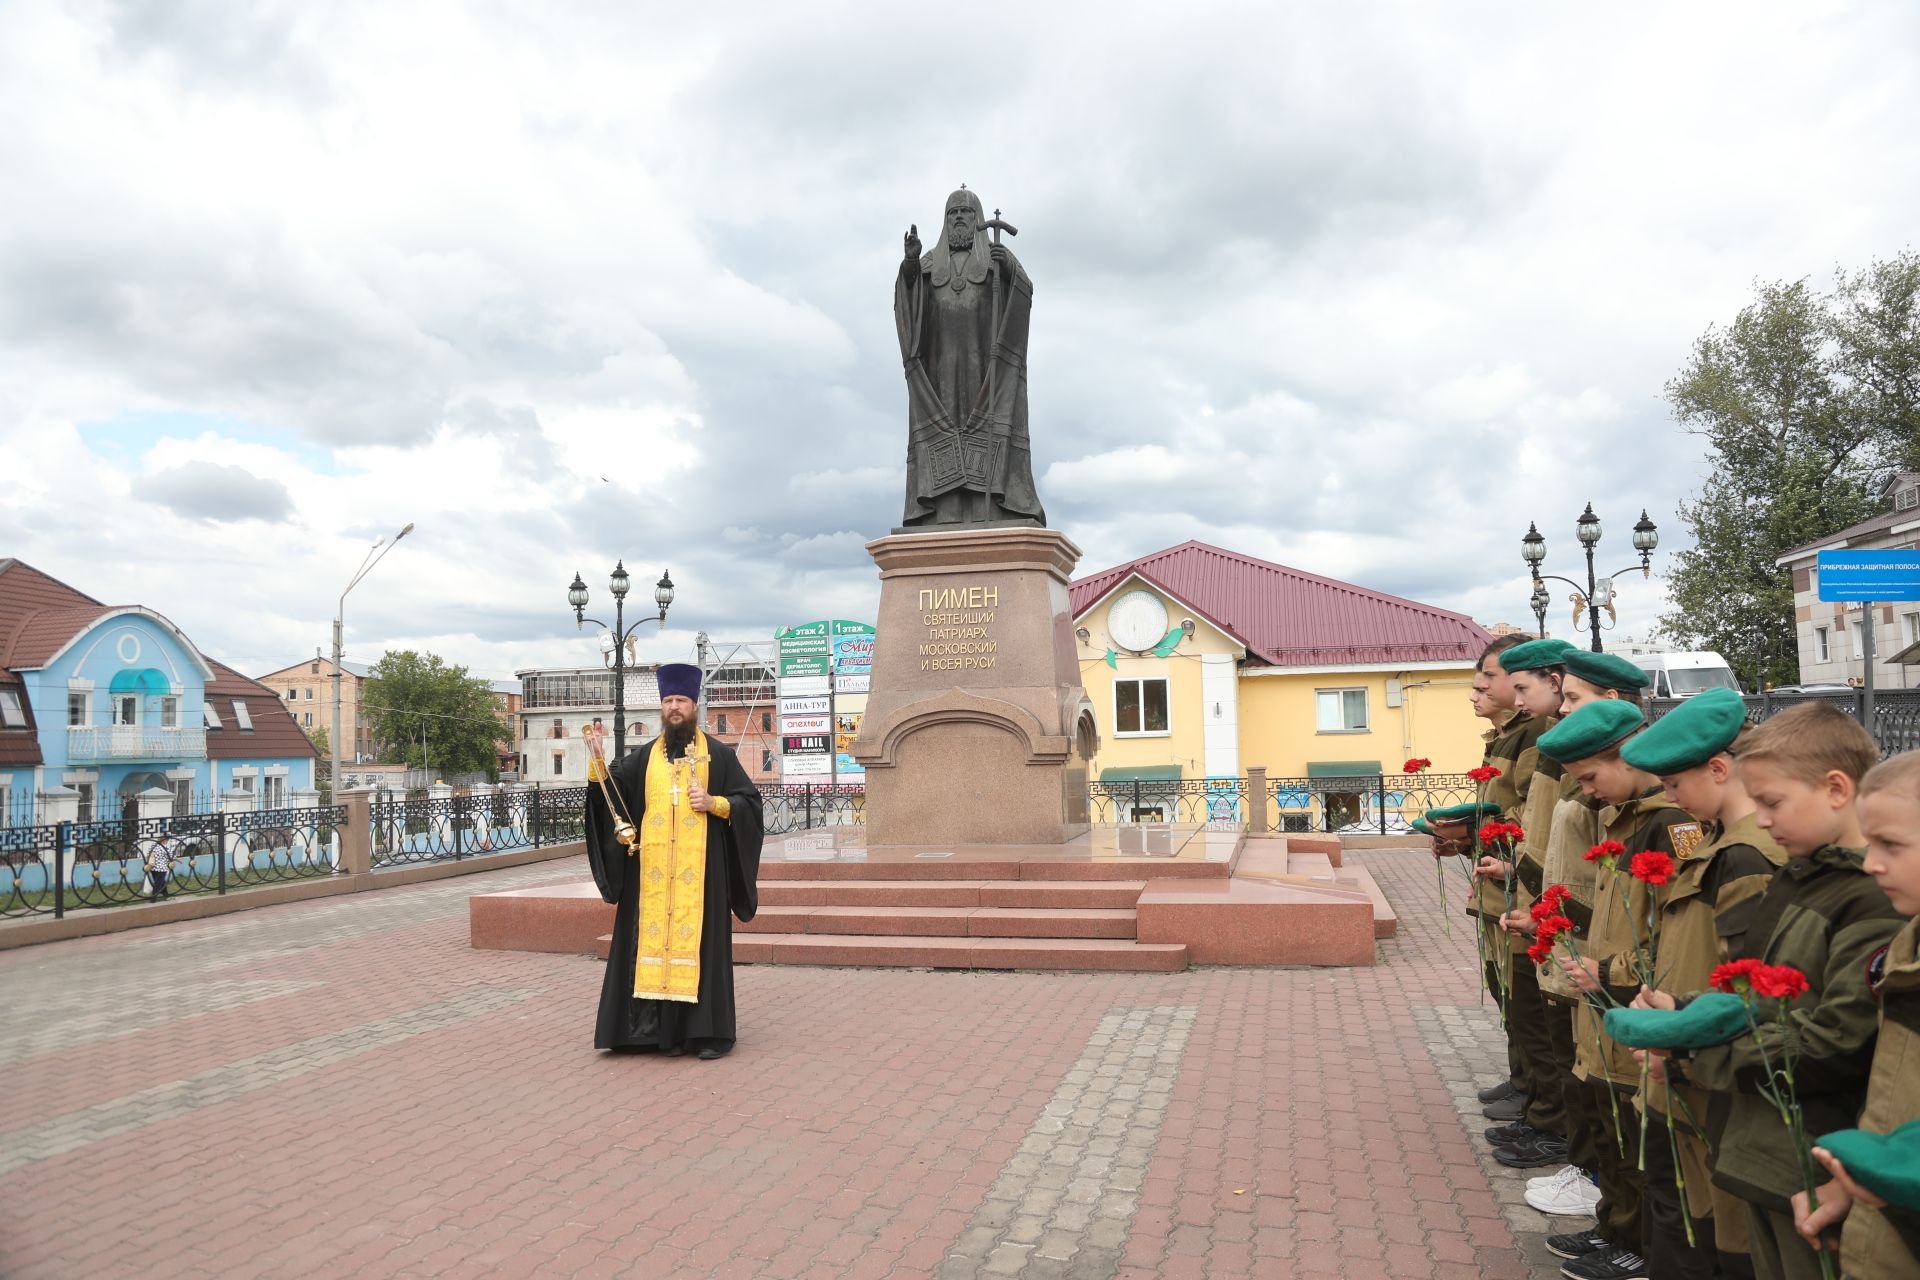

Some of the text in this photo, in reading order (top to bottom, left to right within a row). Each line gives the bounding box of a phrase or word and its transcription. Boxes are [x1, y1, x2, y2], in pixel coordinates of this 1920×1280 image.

[919, 586, 998, 611] ПИМЕН
[818, 624, 825, 634] 2
[835, 623, 841, 633] 1
[930, 627, 988, 640] ПАТРИАРХ
[919, 640, 997, 655] МОСКОВСКИЙ
[921, 656, 996, 670] И ВСЕЯ РУСИ
[784, 702, 827, 710] АННА-ТУР
[787, 720, 824, 728] anextour
